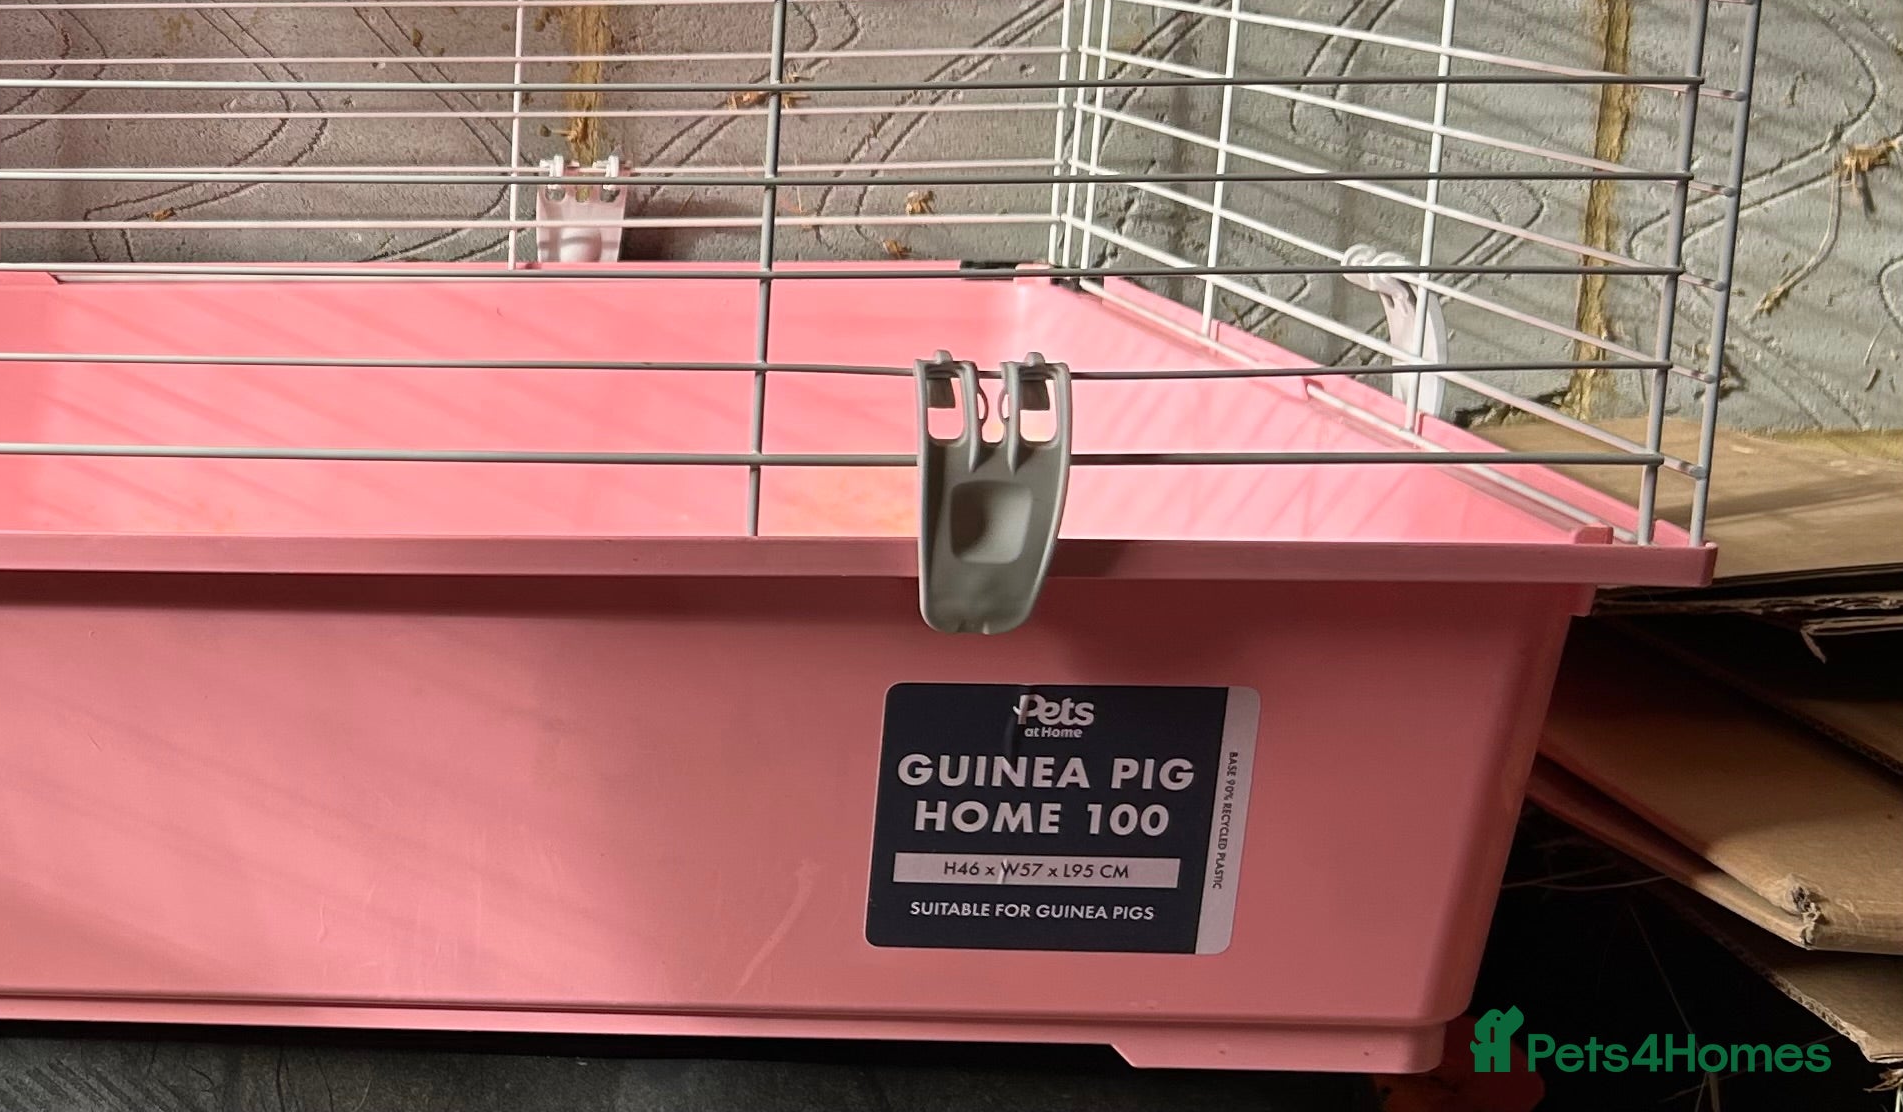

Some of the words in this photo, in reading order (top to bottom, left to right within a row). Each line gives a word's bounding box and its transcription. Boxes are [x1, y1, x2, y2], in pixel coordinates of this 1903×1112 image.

[1013, 694, 1095, 726] Pets
[1024, 727, 1040, 737] at
[1041, 726, 1083, 738] Home
[897, 753, 1091, 789] GUINEA
[1111, 758, 1195, 791] PIG
[1226, 751, 1239, 777] BASE
[1223, 779, 1237, 801] 90%
[914, 800, 1062, 834] HOME
[1087, 803, 1170, 837] 100
[1217, 802, 1233, 851] RECYCLED
[944, 861, 980, 876] H46
[1001, 862, 1043, 877] W57
[1063, 863, 1094, 878] L95
[1099, 864, 1130, 880] CM
[1212, 852, 1227, 890] PLASTIC
[910, 901, 990, 917] SUITABLE
[995, 903, 1031, 918] FOR
[1035, 904, 1108, 920] GUINEA
[1112, 906, 1155, 921] PIGS
